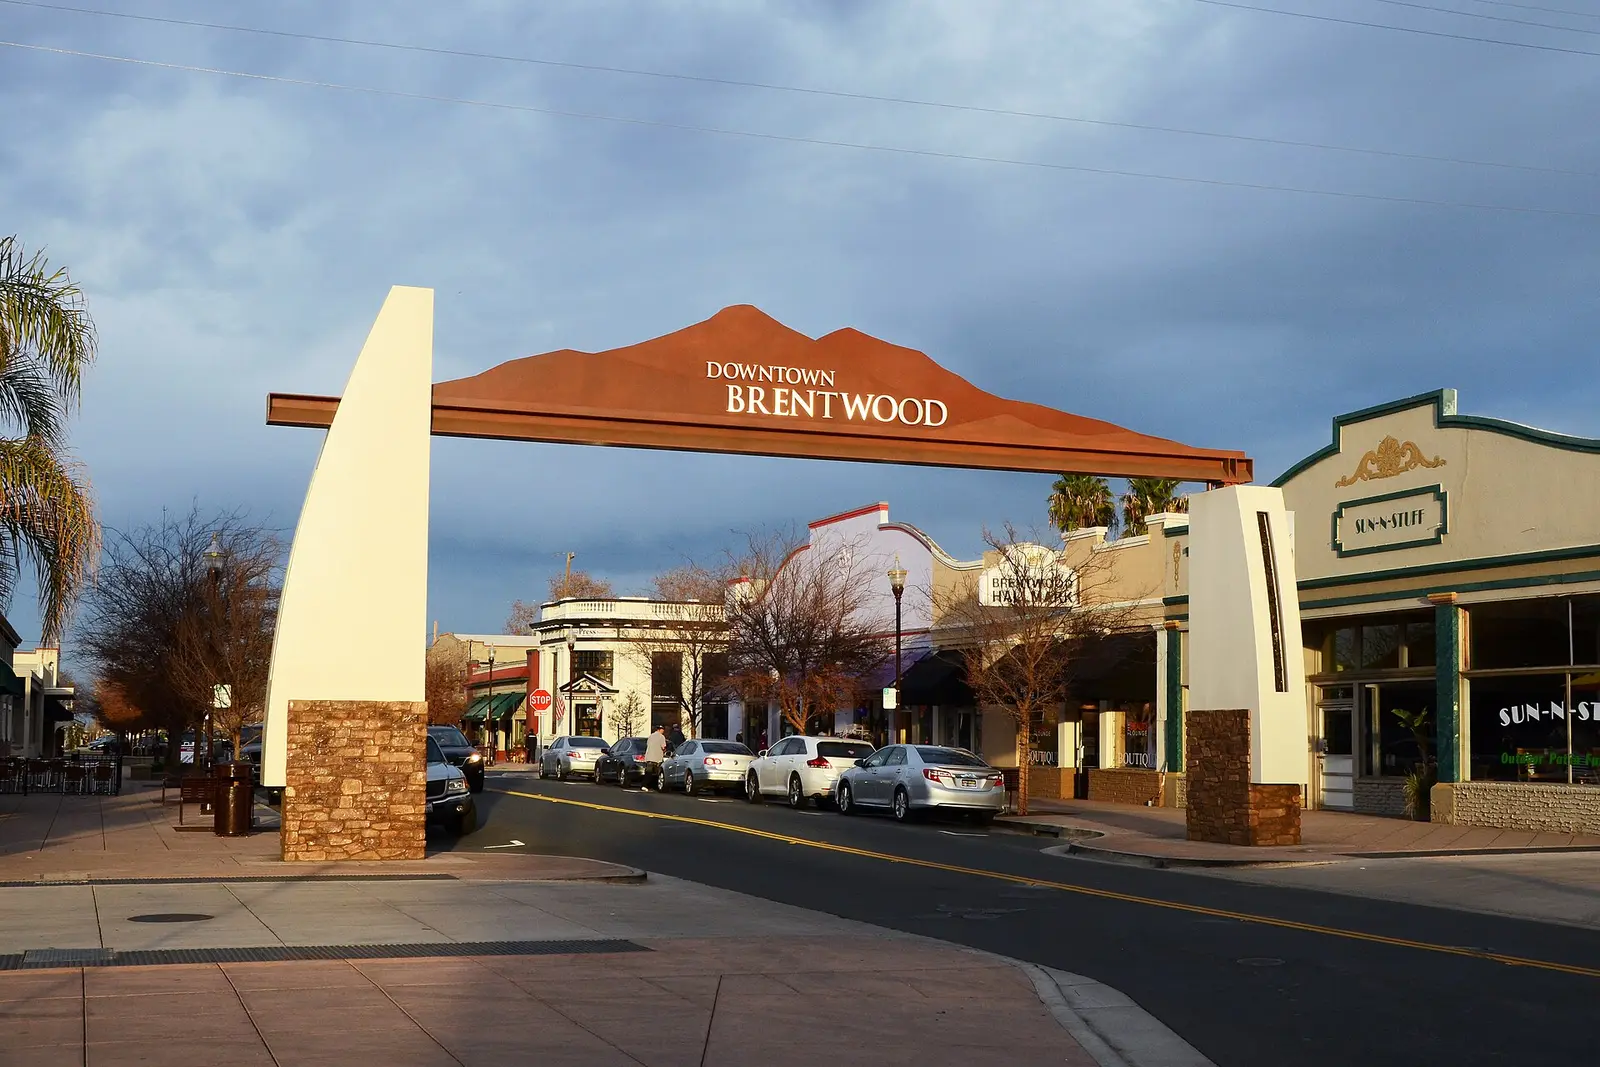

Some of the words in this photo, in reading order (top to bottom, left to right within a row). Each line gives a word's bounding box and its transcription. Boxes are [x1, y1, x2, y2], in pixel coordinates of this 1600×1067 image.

[706, 361, 836, 387] DOWNTOWN
[725, 384, 948, 427] BRENTWOOD
[1355, 508, 1425, 535] SUN-N-STUFF
[992, 590, 1073, 603] HALMARK
[531, 695, 551, 705] STOP
[1028, 750, 1058, 765] OUTIQU
[1549, 752, 1580, 765] Pato
